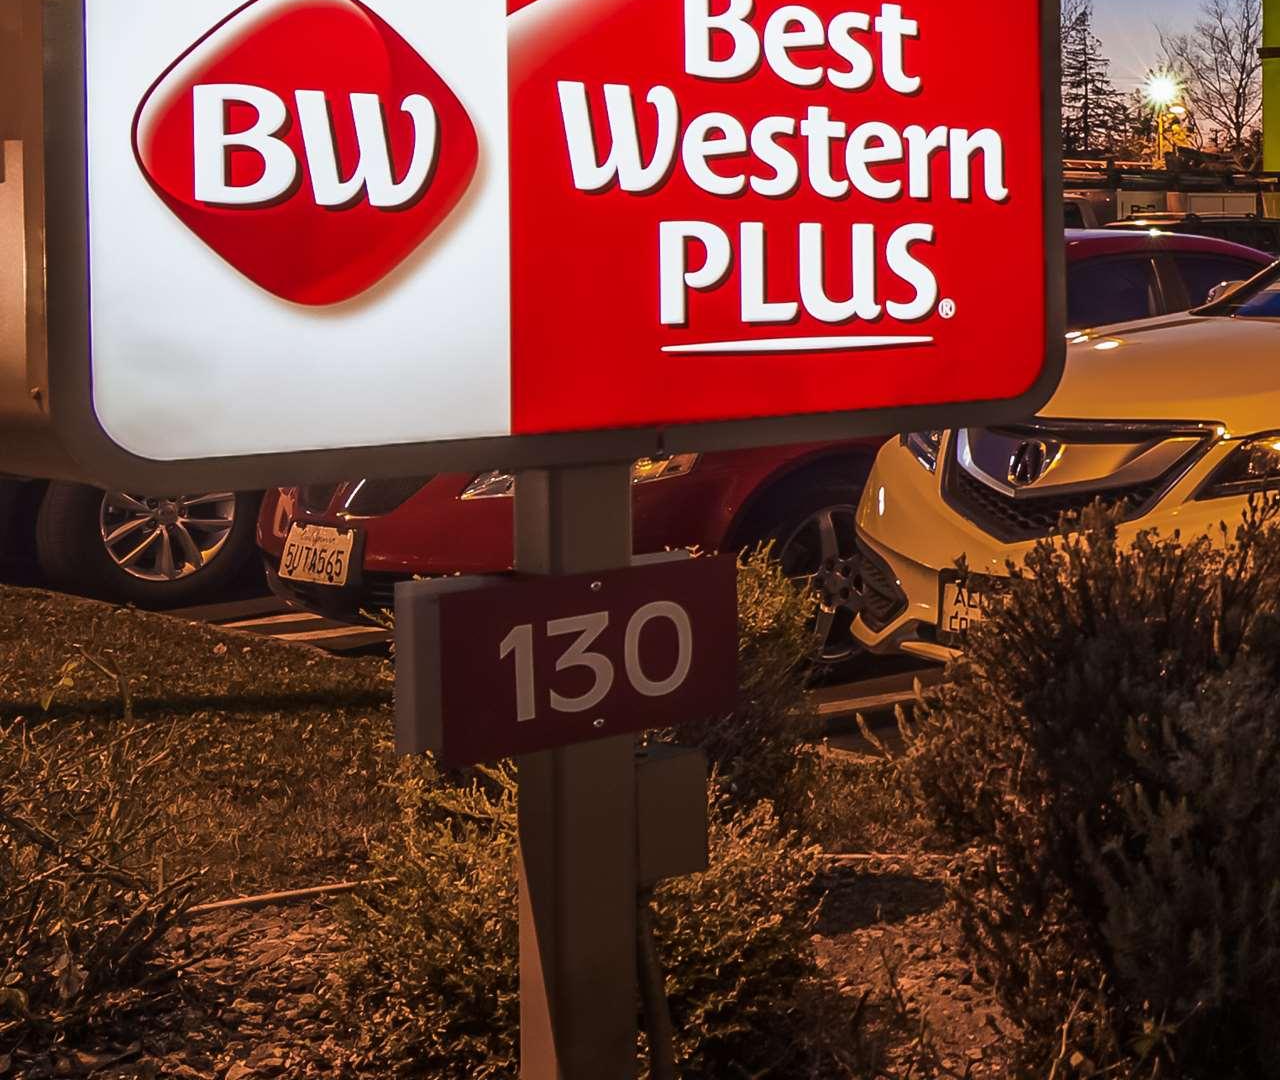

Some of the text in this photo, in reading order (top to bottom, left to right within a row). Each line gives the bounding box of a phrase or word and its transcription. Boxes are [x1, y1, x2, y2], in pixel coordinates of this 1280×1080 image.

[192, 83, 437, 208] BW
[557, 80, 1008, 201] Western
[284, 543, 345, 578] 5UTA565
[499, 600, 694, 723] 130
